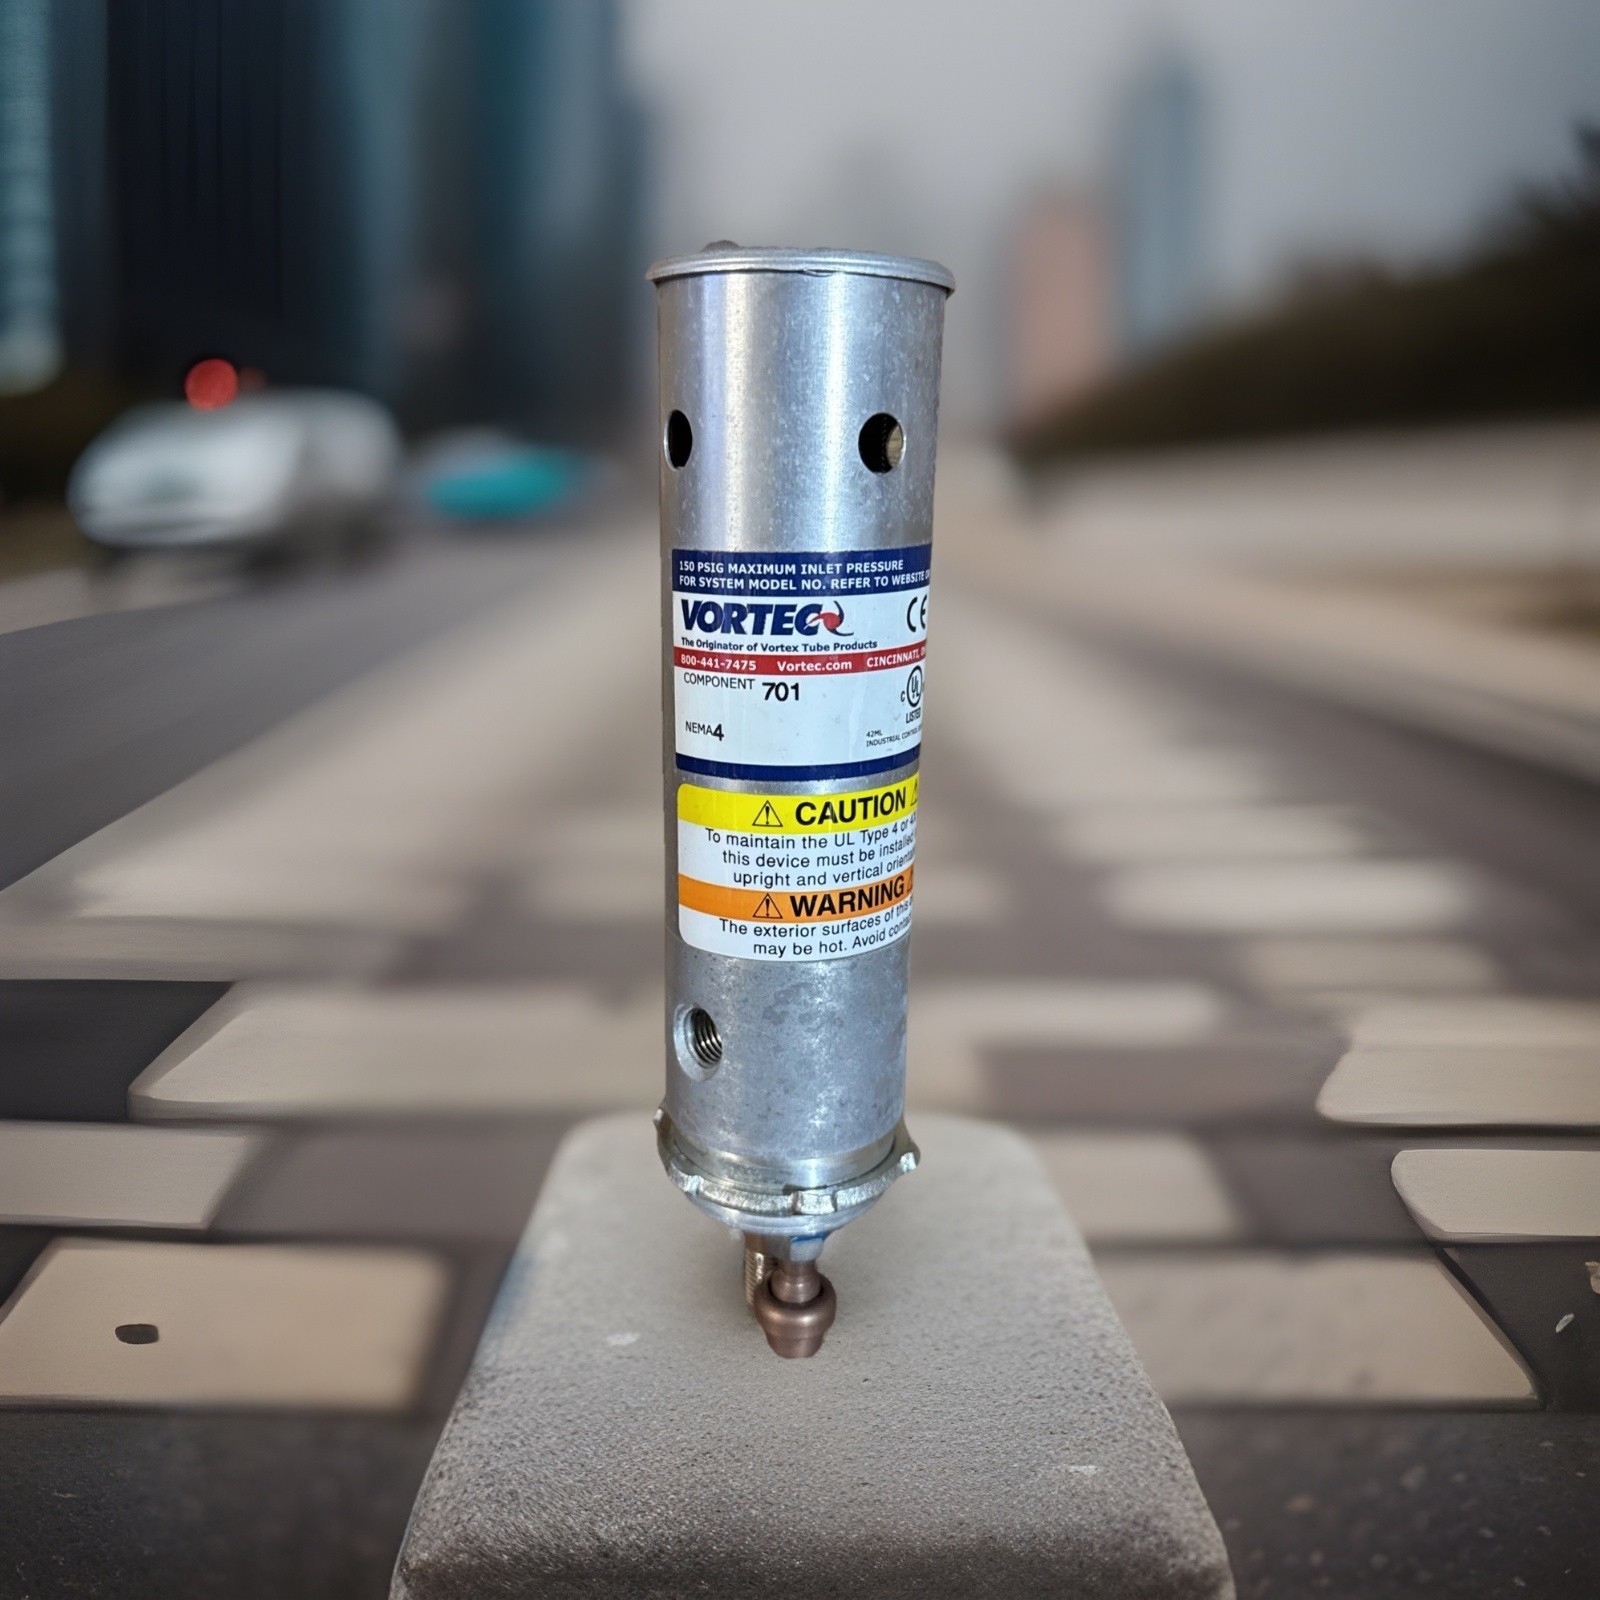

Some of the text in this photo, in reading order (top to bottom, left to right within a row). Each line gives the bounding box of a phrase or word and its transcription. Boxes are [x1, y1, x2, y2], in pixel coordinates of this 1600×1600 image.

[679, 575, 696, 587] FOR
[699, 577, 744, 589] SYSTEM
[749, 579, 797, 591] MODEL
[801, 579, 826, 590] NO.
[831, 578, 871, 590] REFER
[874, 576, 889, 587] TO
[891, 570, 925, 586] WEBSITE
[680, 560, 904, 575] 150 PSIG MAXIMUM INLET PRESSURE
[681, 637, 878, 653] The Originator of Vortex Tube Products
[680, 653, 756, 671] 800-441-7475
[777, 661, 852, 671] Vortec.com
[683, 672, 799, 702] COMPONENT 701
[795, 787, 907, 826] CAUTION
[705, 827, 721, 843] To
[726, 833, 795, 849] maintain
[802, 836, 828, 849] the
[834, 832, 855, 847] UL
[860, 827, 889, 846] Type
[891, 821, 898, 834] 4
[900, 819, 909, 831] or
[722, 850, 750, 866] this
[756, 854, 810, 868] device
[816, 850, 854, 867] must
[859, 848, 875, 863] be
[733, 872, 791, 888] upright
[796, 872, 827, 886] and
[833, 863, 883, 884] vertical
[789, 875, 905, 918] WARNING
[719, 918, 748, 934] The
[753, 925, 816, 938] exterior
[822, 915, 881, 936] surfaces
[884, 907, 895, 922] of
[753, 943, 787, 958] may
[793, 942, 813, 955] be
[819, 941, 847, 954] hot.
[852, 929, 886, 949] Avoid
